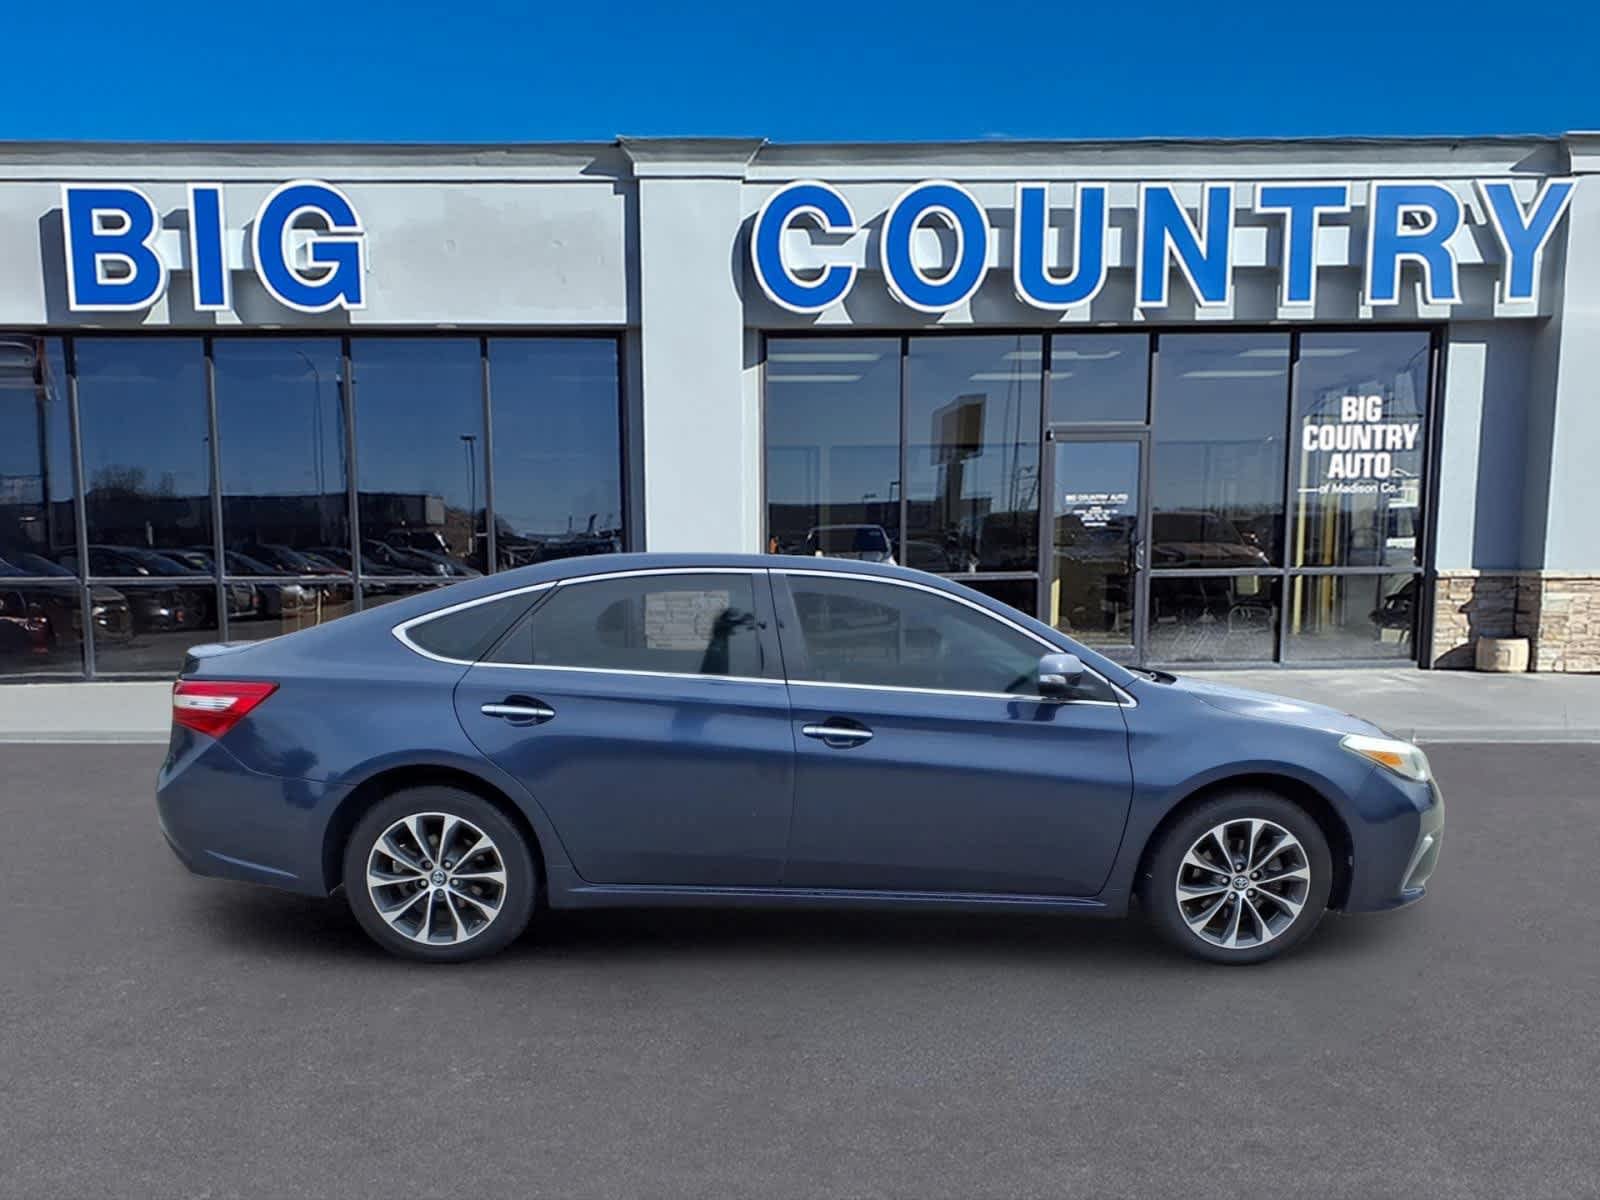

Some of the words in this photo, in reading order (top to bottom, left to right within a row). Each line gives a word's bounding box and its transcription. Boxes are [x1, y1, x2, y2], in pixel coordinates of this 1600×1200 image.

[61, 180, 367, 313] BIG
[751, 179, 1576, 313] COUNTRY
[1341, 395, 1382, 422] BIG
[1303, 424, 1419, 451] COUNTRY
[1327, 453, 1391, 479] AUTO
[1319, 482, 1330, 494] of
[1331, 482, 1378, 493] Madison
[1381, 482, 1399, 493] Co.
